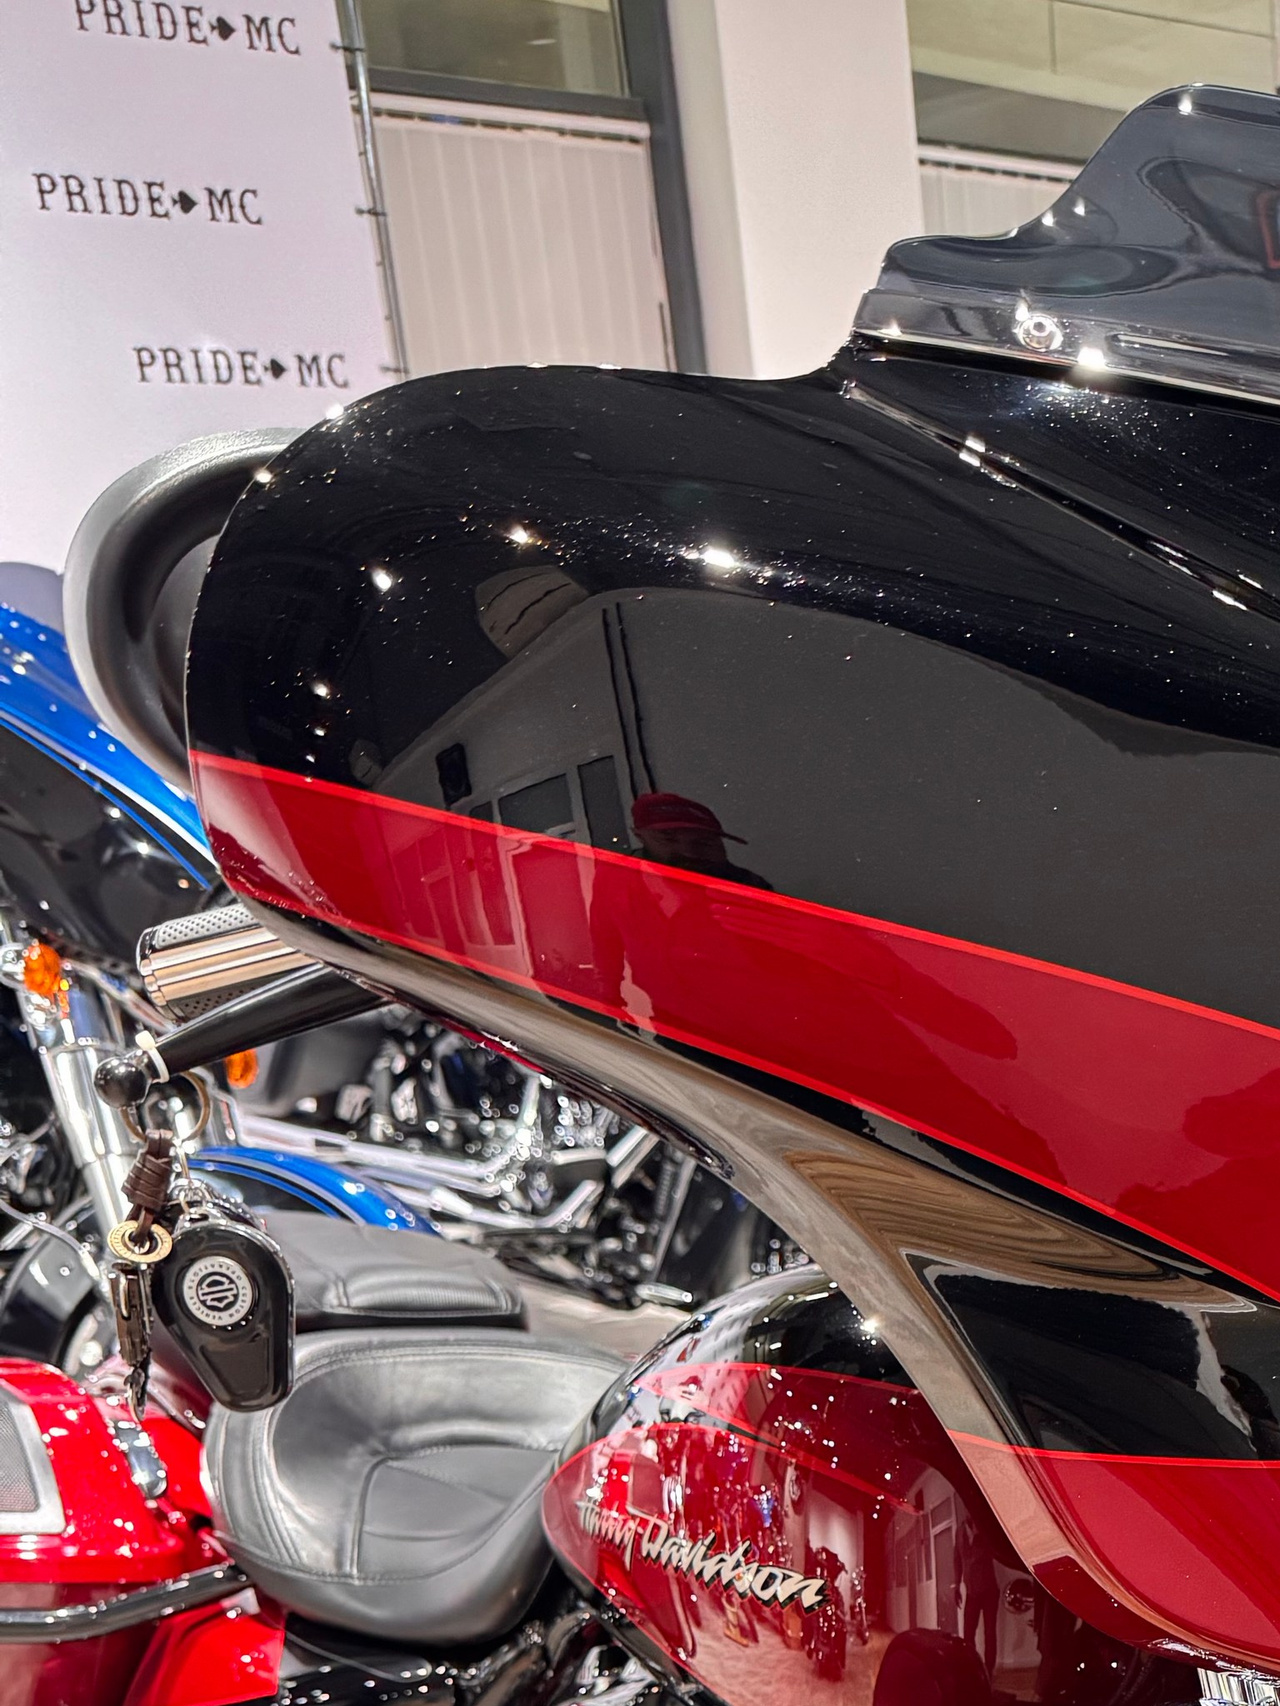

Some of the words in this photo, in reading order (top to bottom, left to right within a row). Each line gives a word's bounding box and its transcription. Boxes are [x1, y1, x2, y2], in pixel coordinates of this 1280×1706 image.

[75, 0, 209, 46] PRIDE
[242, 13, 301, 56] MC
[32, 173, 171, 220] PRIDE
[204, 187, 264, 226] MC
[132, 347, 265, 387] PRIDE
[295, 353, 350, 389] MC
